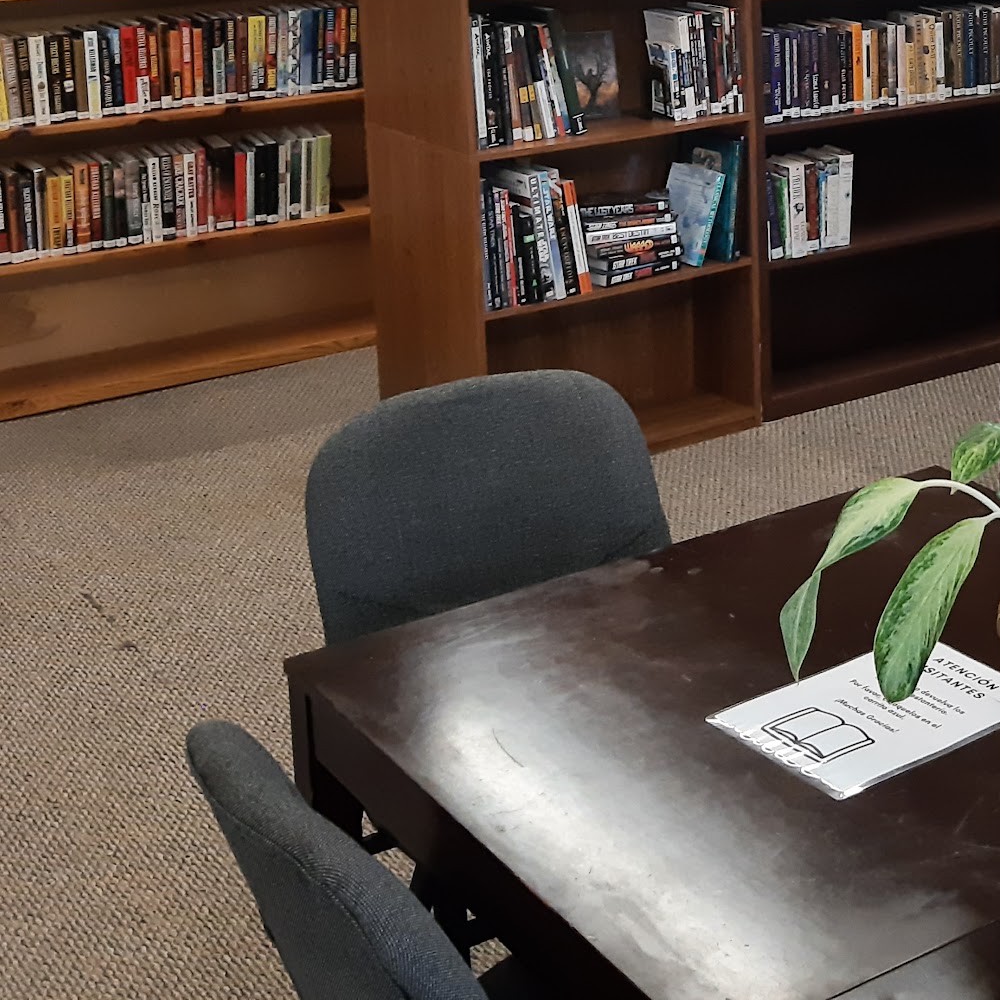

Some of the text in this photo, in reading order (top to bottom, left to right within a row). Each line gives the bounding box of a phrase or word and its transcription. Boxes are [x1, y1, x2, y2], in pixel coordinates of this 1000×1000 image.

[530, 178, 545, 237] ULTIMATE
[613, 204, 634, 215] YEARS
[559, 227, 573, 284] ENCYCLOPEDIA
[613, 257, 638, 269] STAR TREK
[611, 273, 633, 285] STAR TREK
[933, 658, 1000, 690] ATENCIÓN
[850, 679, 862, 688] Por
[954, 705, 965, 715] los
[921, 717, 931, 725] en
